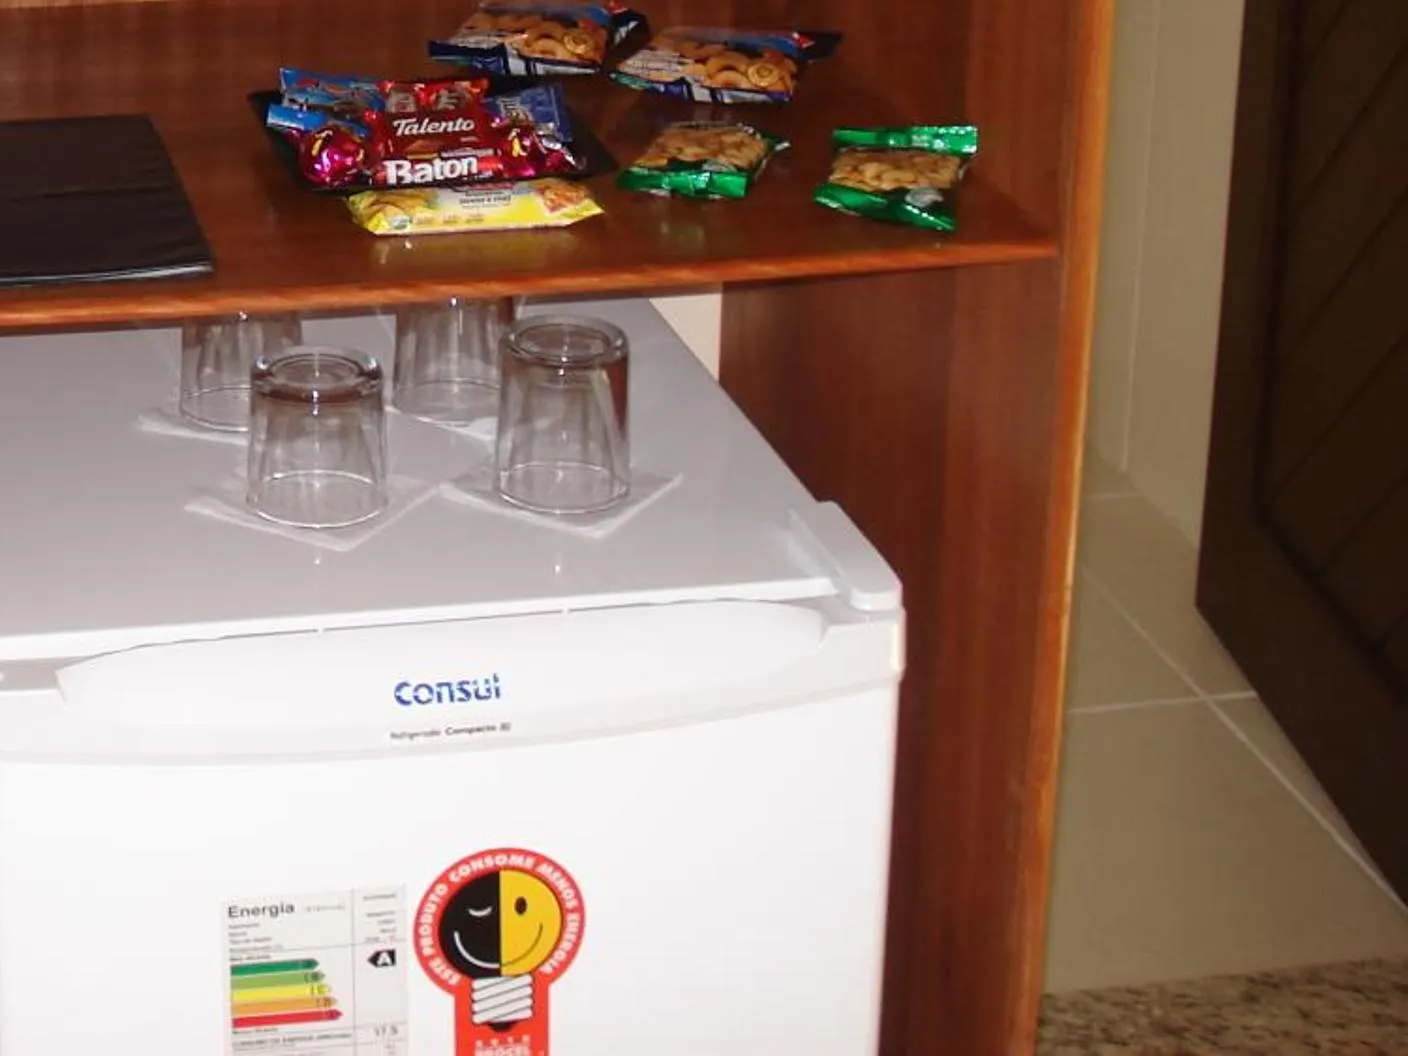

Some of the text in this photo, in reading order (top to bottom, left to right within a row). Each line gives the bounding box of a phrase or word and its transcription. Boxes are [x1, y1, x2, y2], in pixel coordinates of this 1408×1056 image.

[393, 117, 475, 136] Talento
[382, 155, 479, 185] Baton
[228, 901, 295, 919] Energia
[418, 883, 449, 957] PRODUTO
[448, 853, 537, 883] CONSOME
[536, 863, 579, 910] MENOS
[376, 950, 393, 966] A
